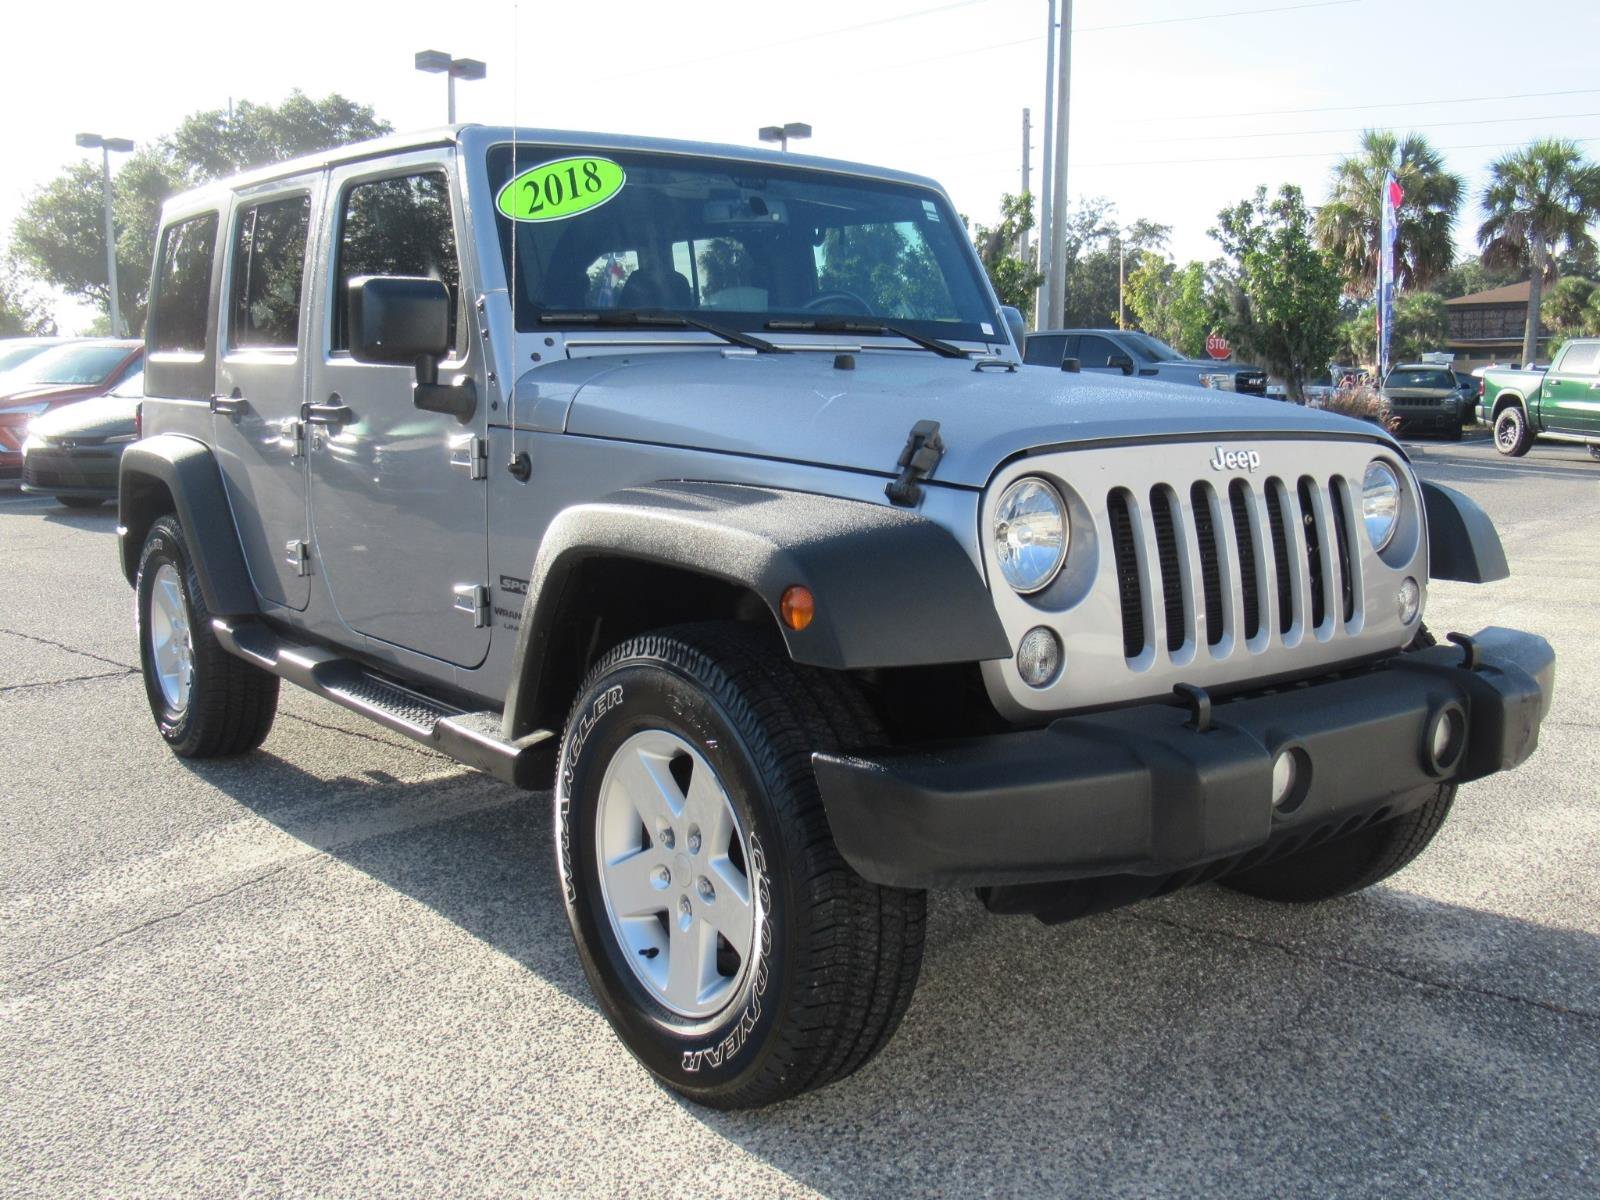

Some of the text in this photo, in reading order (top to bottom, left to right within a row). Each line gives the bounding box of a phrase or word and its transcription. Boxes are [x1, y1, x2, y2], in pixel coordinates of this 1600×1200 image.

[523, 161, 602, 214] 2018
[1210, 446, 1260, 473] Jeep
[502, 579, 529, 592] SPO
[495, 607, 521, 620] WRAN
[556, 685, 624, 903] WRANGLER
[682, 831, 772, 1072] GOODYEAR
